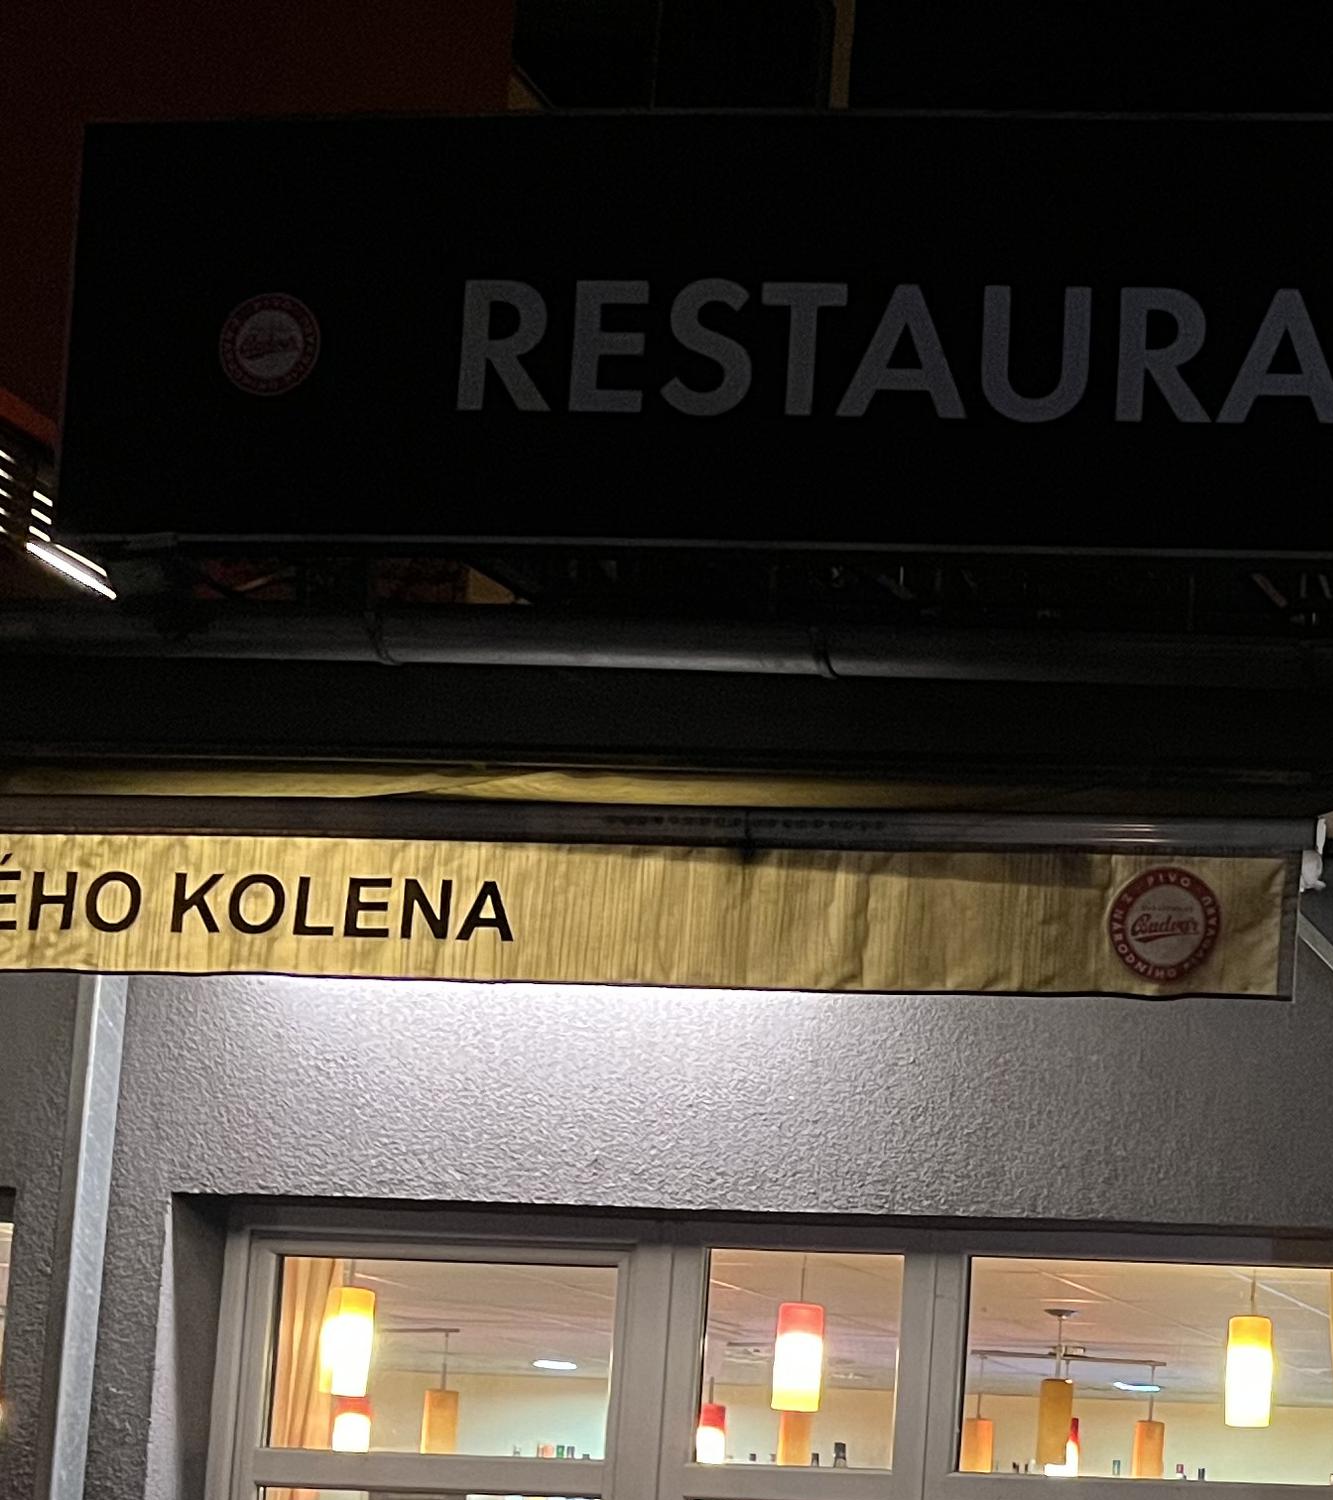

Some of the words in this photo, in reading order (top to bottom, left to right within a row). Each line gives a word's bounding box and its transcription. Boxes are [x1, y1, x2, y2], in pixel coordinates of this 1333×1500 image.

[1147, 871, 1190, 888] PIVO
[167, 868, 515, 943] KOLENA
[1131, 913, 1199, 943] Budvar
